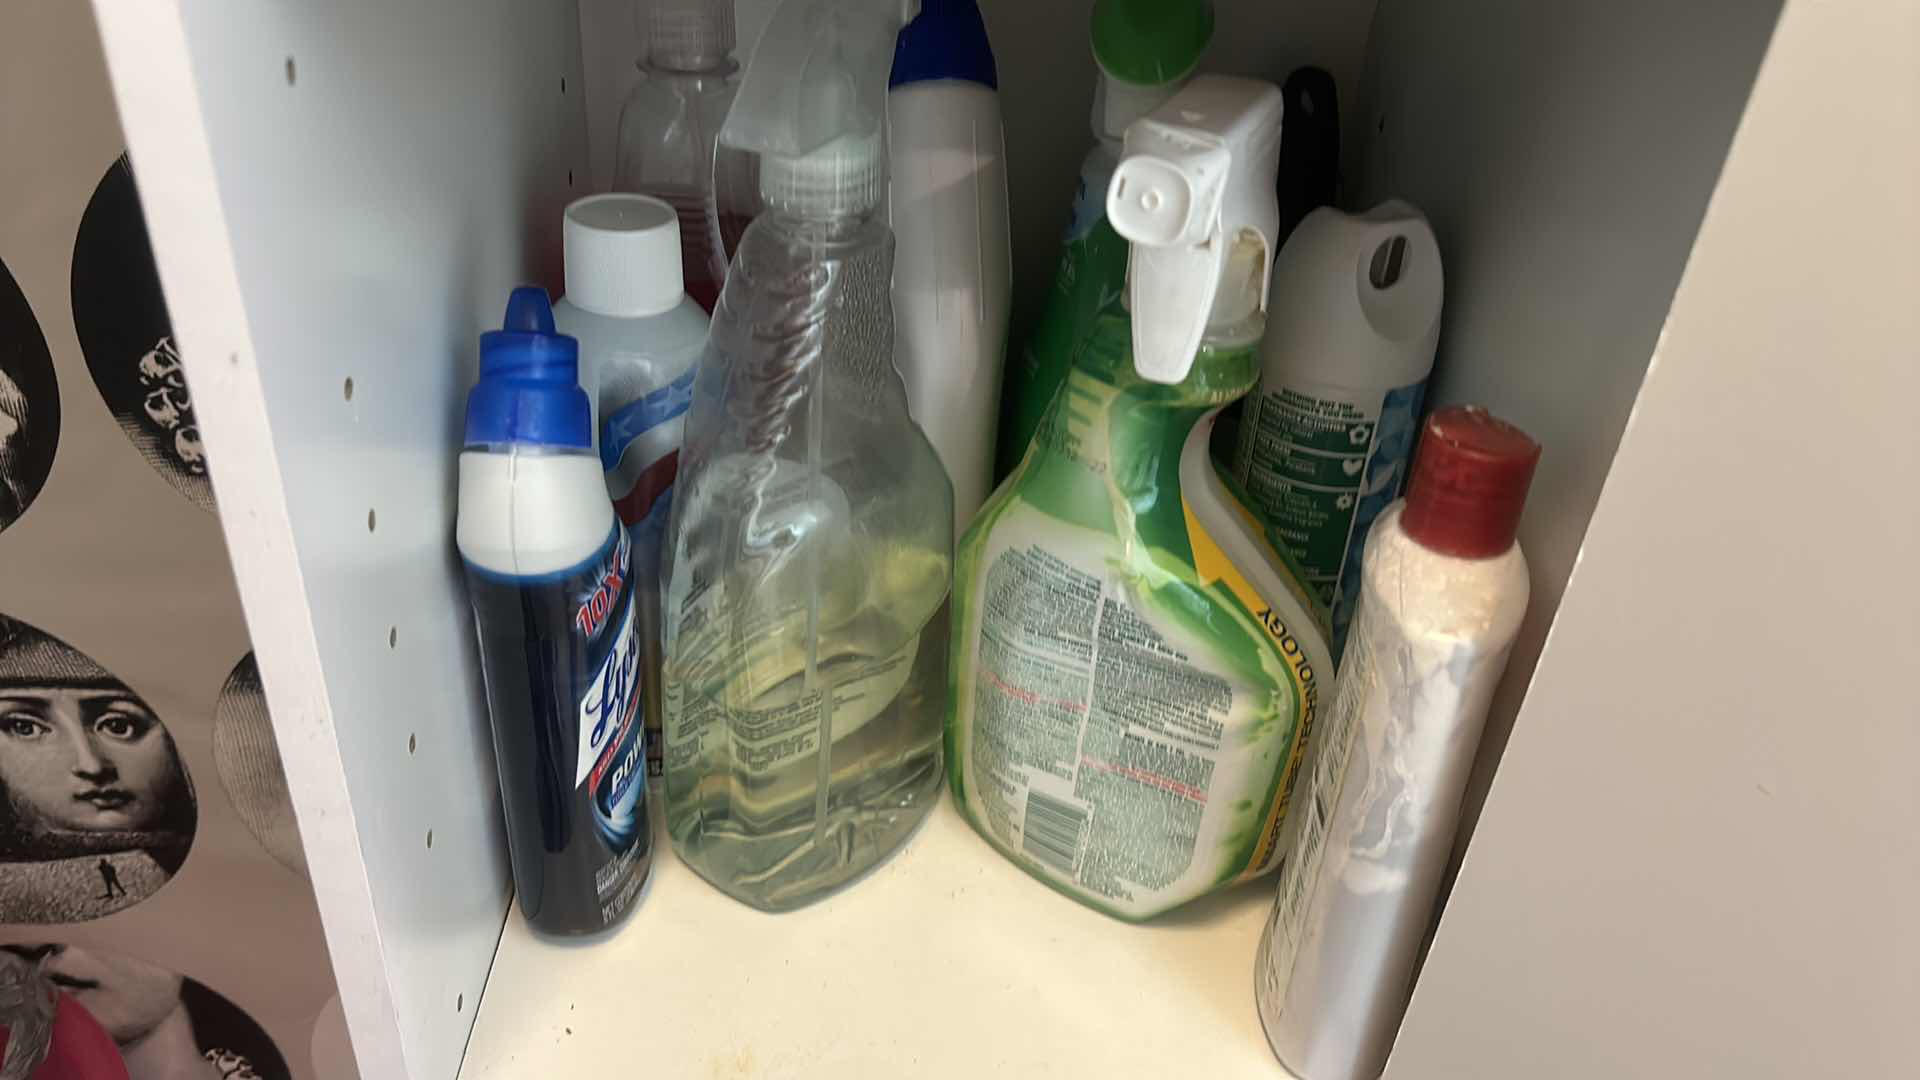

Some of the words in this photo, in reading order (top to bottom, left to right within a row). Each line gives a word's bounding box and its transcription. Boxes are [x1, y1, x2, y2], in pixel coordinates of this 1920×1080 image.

[575, 552, 624, 638] 10X
[586, 626, 639, 749] Lyso
[1258, 607, 1318, 747] TECHNOLOGY
[611, 722, 644, 795] POW
